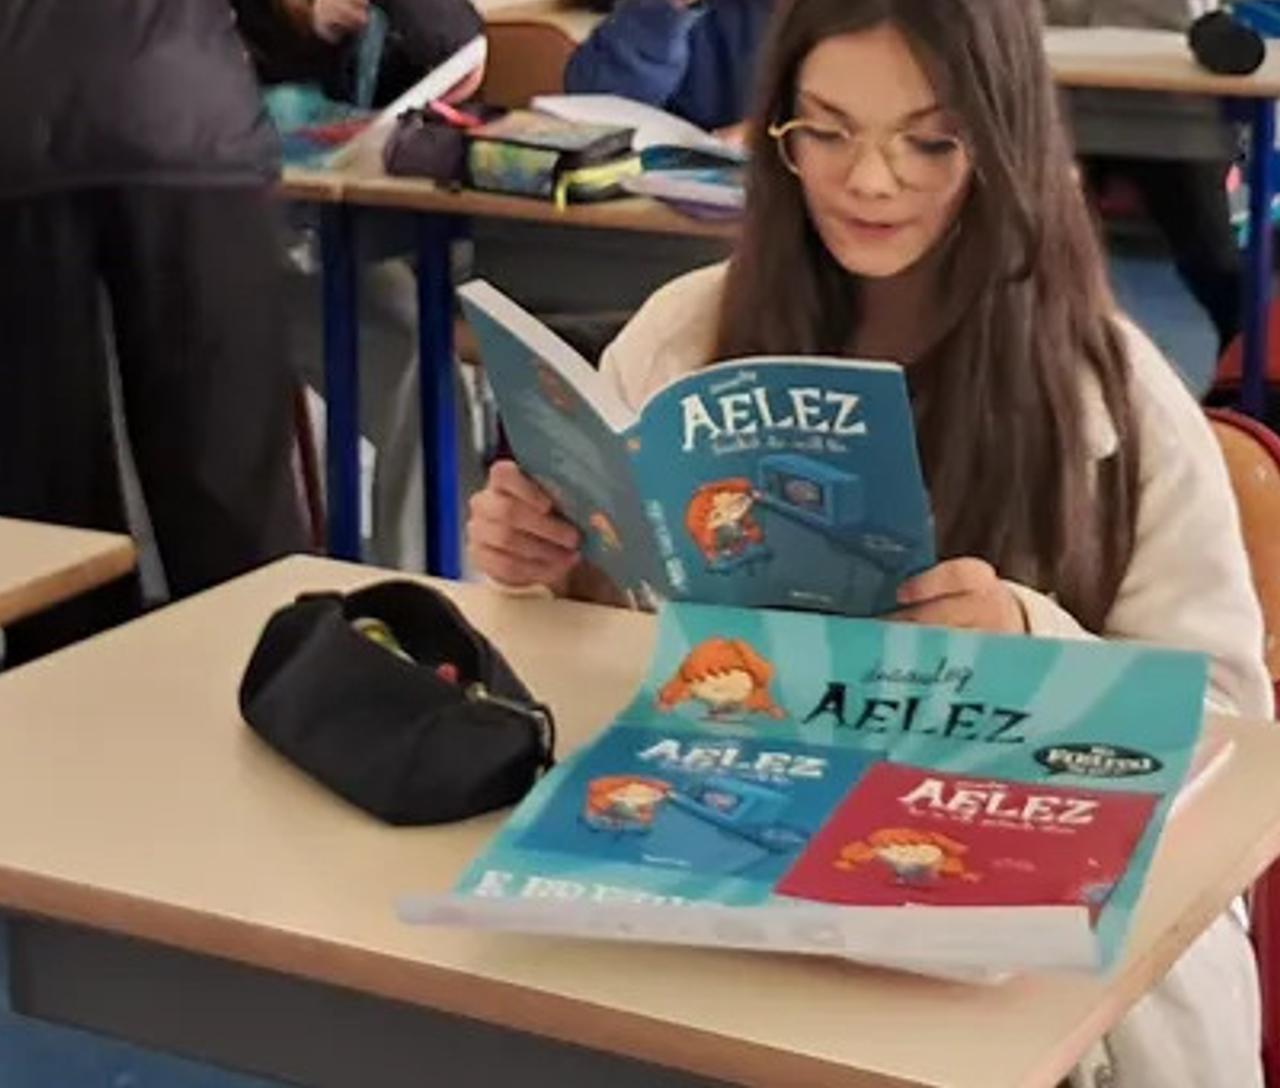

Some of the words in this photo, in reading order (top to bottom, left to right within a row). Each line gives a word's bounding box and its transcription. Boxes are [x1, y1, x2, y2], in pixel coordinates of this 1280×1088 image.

[680, 386, 867, 452] AELEZ
[802, 681, 1032, 744] AELEZ
[637, 738, 828, 778] AELEZ
[897, 777, 1100, 825] AELEZ
